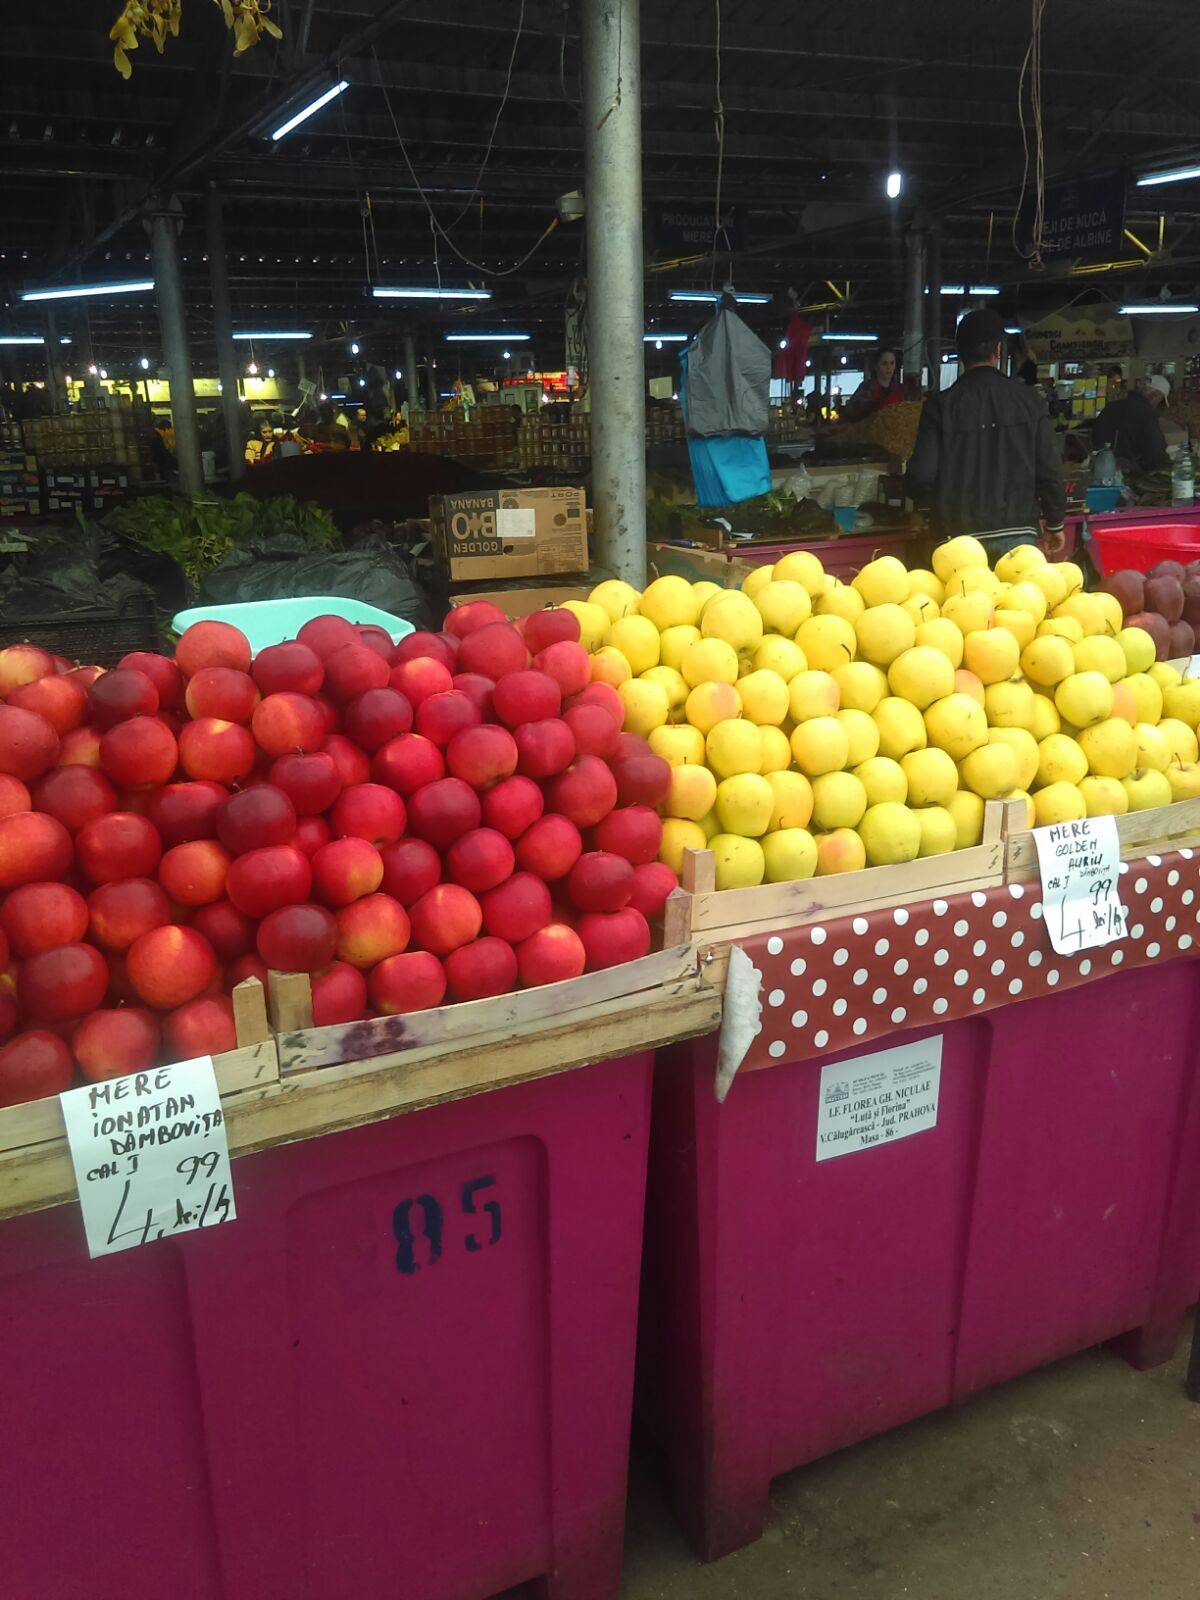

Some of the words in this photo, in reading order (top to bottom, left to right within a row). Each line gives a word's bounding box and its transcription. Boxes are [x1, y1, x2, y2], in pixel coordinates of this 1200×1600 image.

[1060, 217, 1074, 232] DE
[1073, 229, 1113, 249] ALBINE
[450, 497, 494, 511] BANANA
[452, 541, 499, 554] GOLDEN
[1049, 820, 1091, 843] MERE
[1056, 839, 1098, 857] GOLDEN
[1089, 878, 1112, 906] 99
[88, 1068, 172, 1110] MERE
[843, 1096, 878, 1115] FLOREA
[896, 1080, 932, 1099] NICULAE
[899, 1103, 937, 1123] PRAHOVA
[860, 1133, 880, 1145] Masa
[86, 1162, 120, 1181] CAL
[176, 1152, 221, 1186] 99
